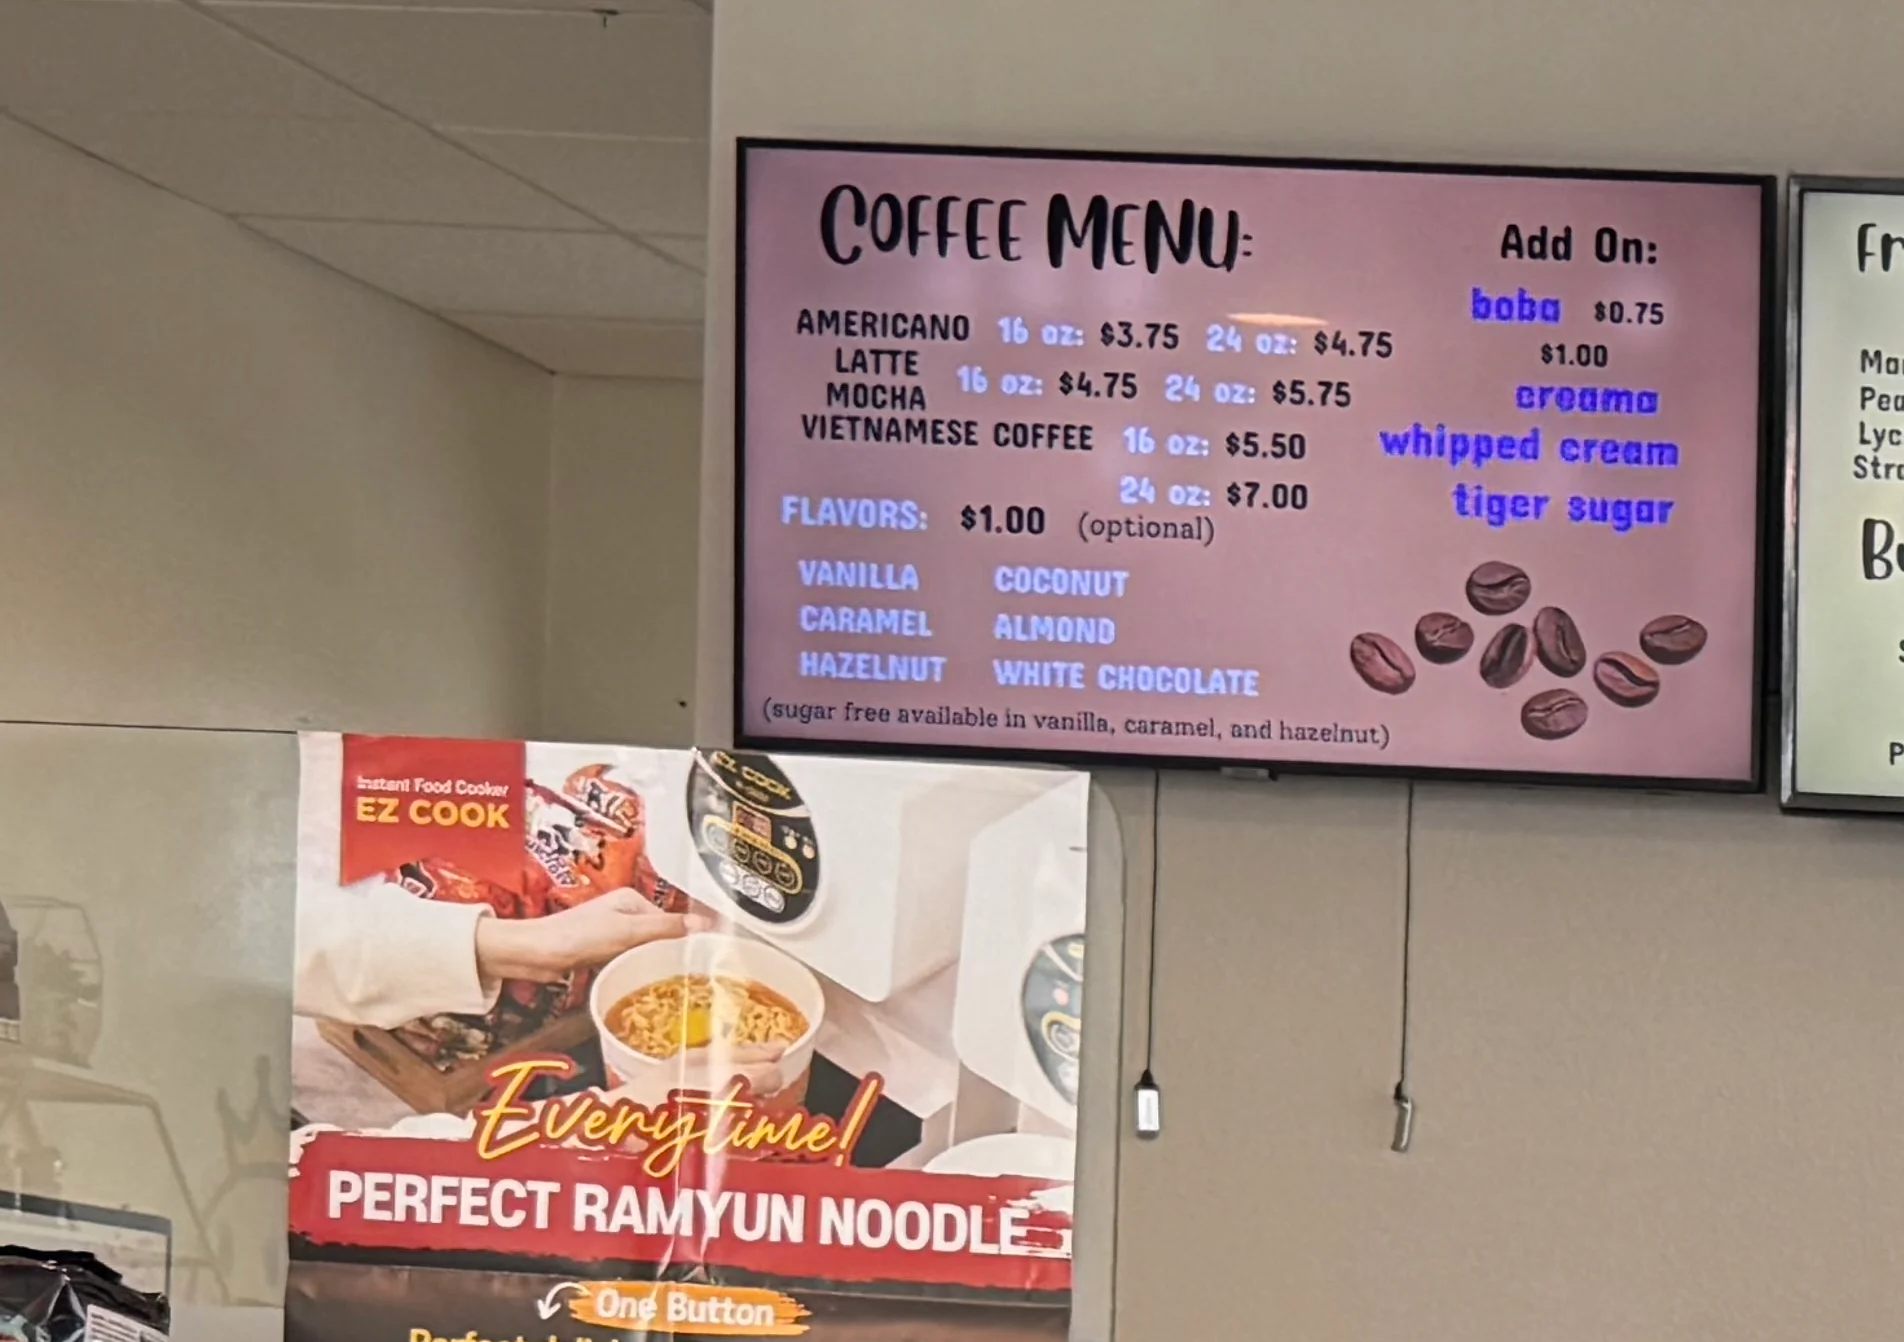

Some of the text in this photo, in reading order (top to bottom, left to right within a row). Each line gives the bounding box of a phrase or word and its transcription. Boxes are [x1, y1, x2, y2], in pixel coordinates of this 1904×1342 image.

[820, 184, 1253, 275] COFFEE MENU:
[1500, 223, 1657, 265] Add On:
[1471, 287, 1665, 326] boba $0.75
[797, 308, 1393, 359] AMERICANO 16 oz: $3.75 24 oz: $4.75
[1515, 385, 1658, 414] creama
[781, 495, 1215, 547] FLAVORS: $1.00 (optional)
[1453, 483, 1674, 532] tiger sugar
[798, 560, 919, 591] VANILLA
[992, 659, 1260, 697] WHITE CHOCOLATE
[763, 696, 1390, 750] (sugar free available in vanilla, caramel, and hazelnut)
[357, 775, 510, 798] Instant Food Cooker
[357, 798, 510, 829] EZ COOK
[476, 1059, 884, 1178] Everytime!
[329, 1170, 559, 1229] PERFECT
[573, 1183, 804, 1242] RAMYUN
[596, 1289, 775, 1326] One Button
